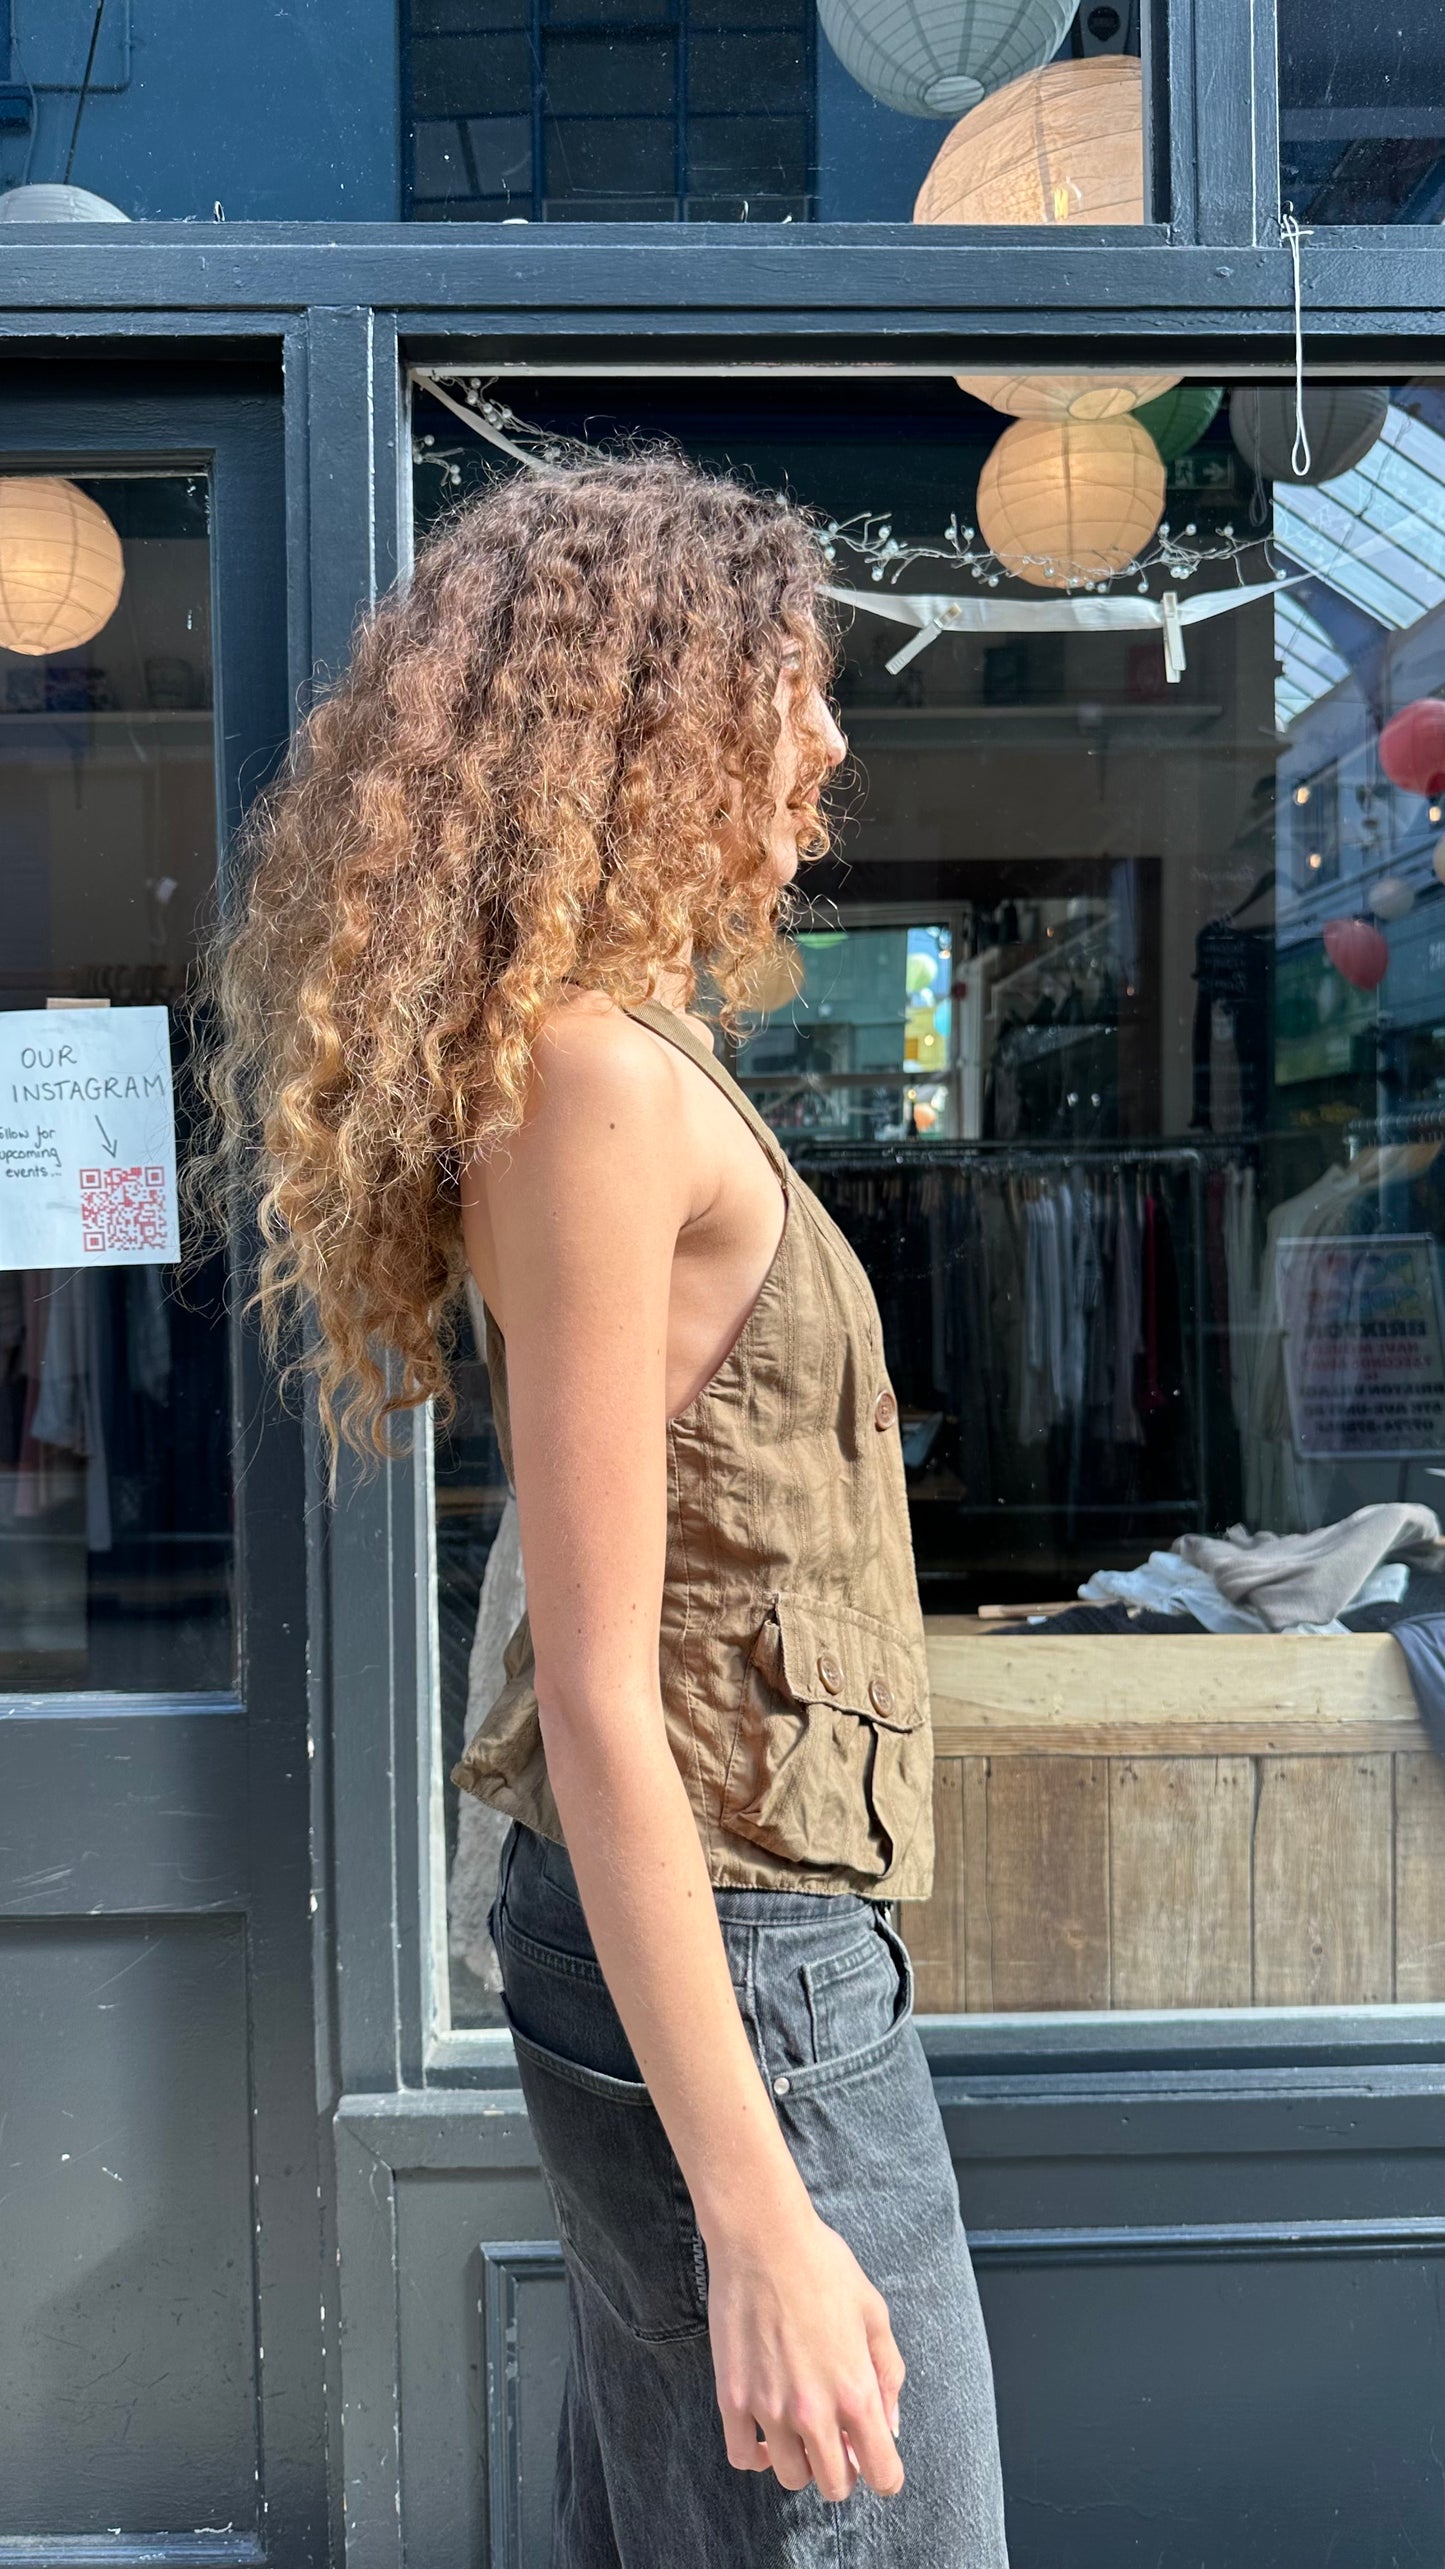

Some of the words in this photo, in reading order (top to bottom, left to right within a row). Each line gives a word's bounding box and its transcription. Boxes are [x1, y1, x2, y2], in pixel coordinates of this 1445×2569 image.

[21, 1045, 77, 1069] OUR
[12, 1074, 166, 1103] INSTAGRAM
[0, 1126, 29, 1139] ollow
[35, 1125, 56, 1149] for
[0, 1147, 62, 1168] upcoming
